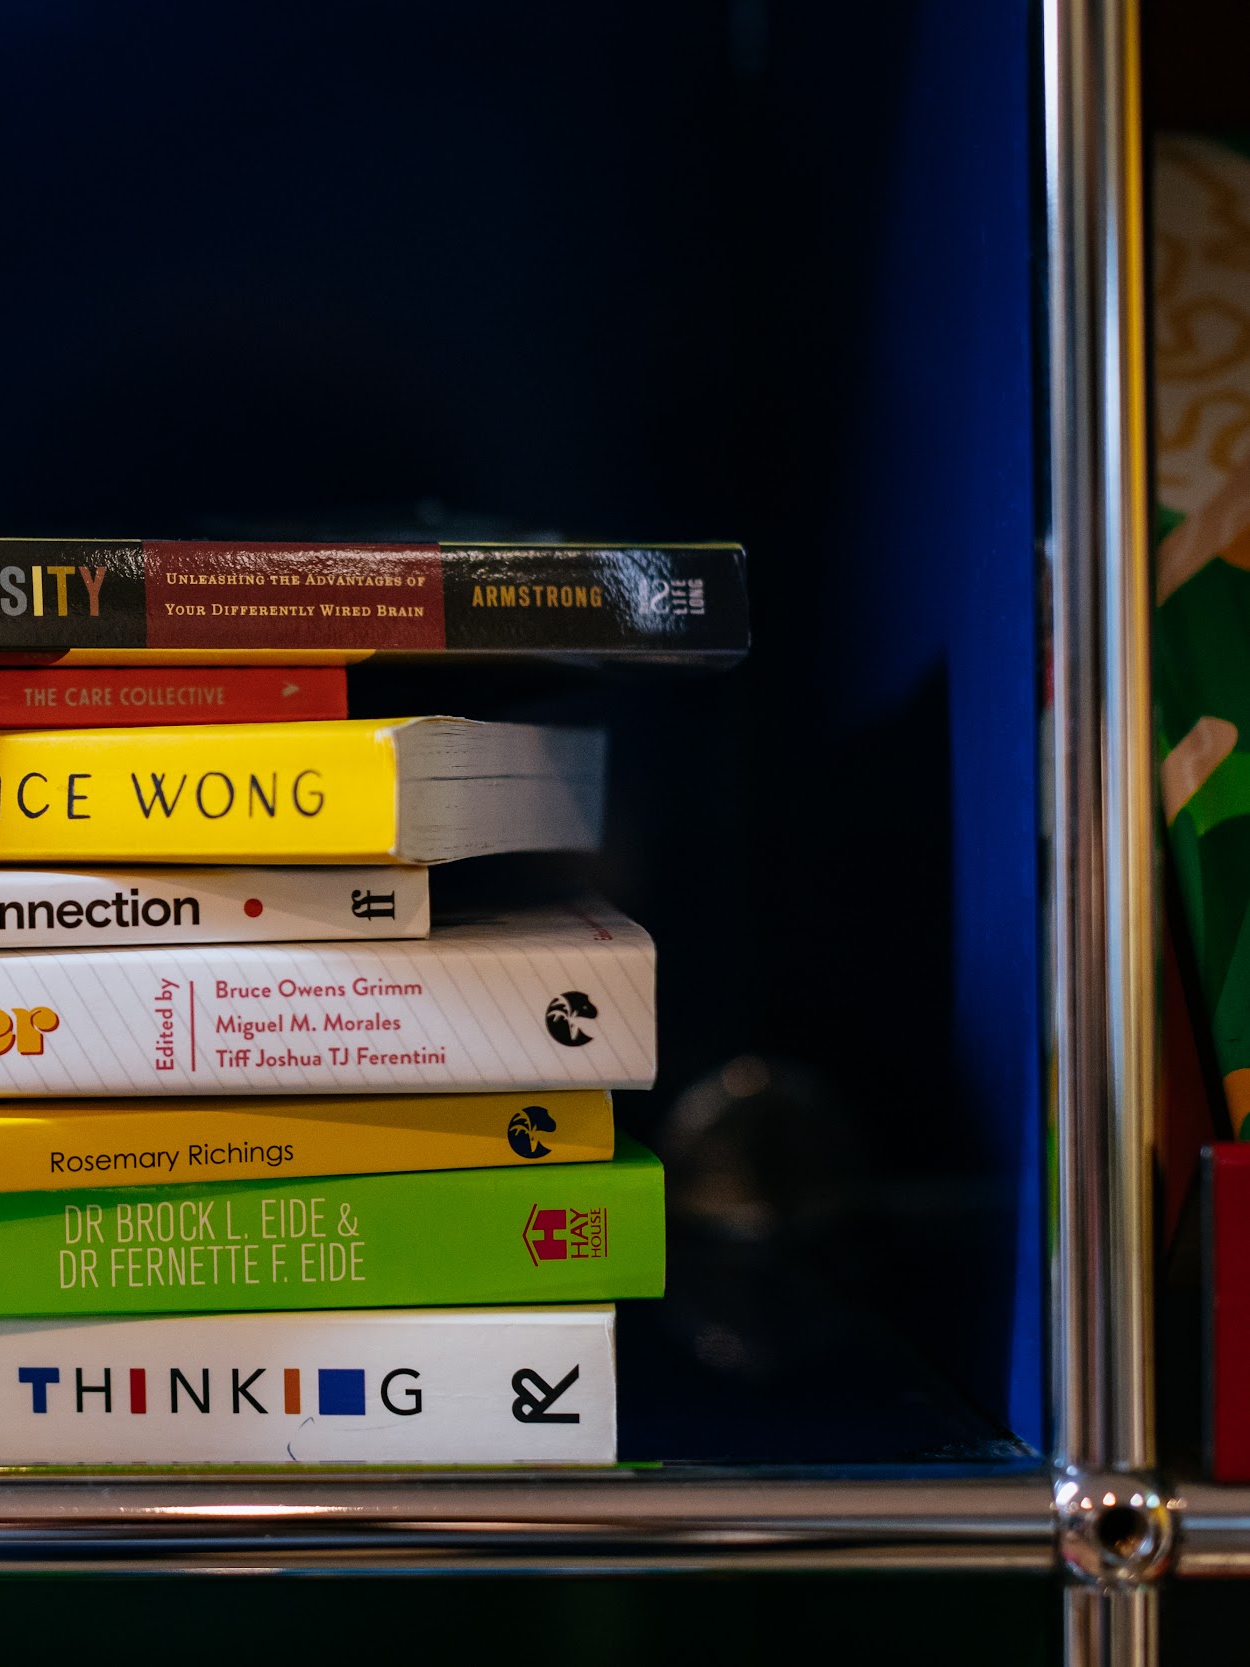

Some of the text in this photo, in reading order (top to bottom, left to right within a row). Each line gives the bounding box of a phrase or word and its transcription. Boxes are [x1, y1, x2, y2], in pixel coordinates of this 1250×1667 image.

[166, 572, 426, 588] UNLEASHING THE ADVANTAGES OF
[472, 585, 603, 608] ARMSTRONG
[688, 578, 705, 615] LONG
[165, 603, 424, 617] YOUR DIFFERENTLY WIRED BRAIN
[670, 579, 687, 615] LIFE
[24, 686, 225, 707] THE CARE COLLECTIVE
[130, 770, 326, 820] WONG
[215, 977, 423, 999] Bruce Owens Grimm
[155, 978, 180, 1071] Edited by
[215, 1012, 401, 1040] Miguel M. Morales
[215, 1045, 446, 1070] Tiff Joshua TJ Ferentini
[51, 1141, 294, 1172] Rosemary Richings
[65, 1197, 359, 1244] DR BROCK L. EIDE &
[570, 1208, 589, 1258] HAY
[591, 1208, 602, 1258] HOUSE
[59, 1242, 366, 1288] DR FERNETTE F. EIDE
